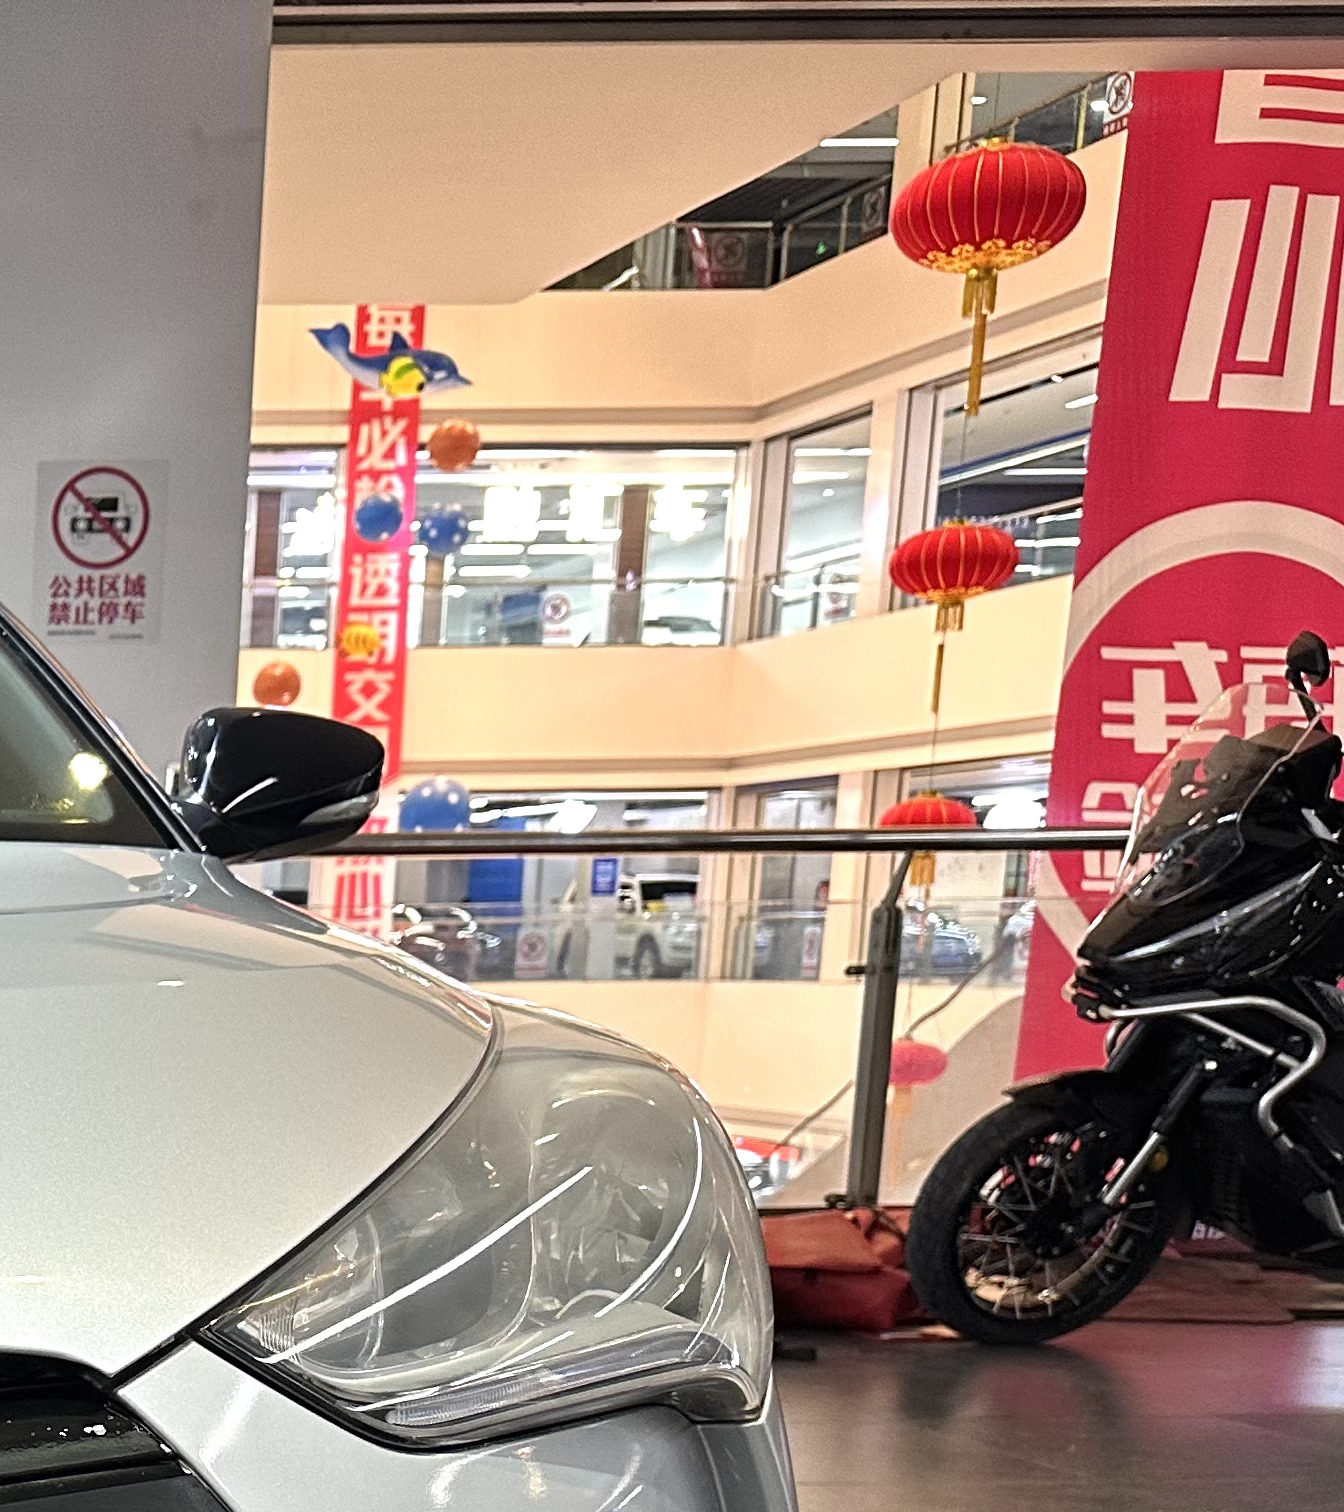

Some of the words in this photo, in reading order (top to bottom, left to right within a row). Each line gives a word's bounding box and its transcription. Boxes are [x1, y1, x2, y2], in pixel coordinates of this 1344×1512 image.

[49, 573, 146, 598] 公共区域
[48, 600, 145, 625] 禁止停车
